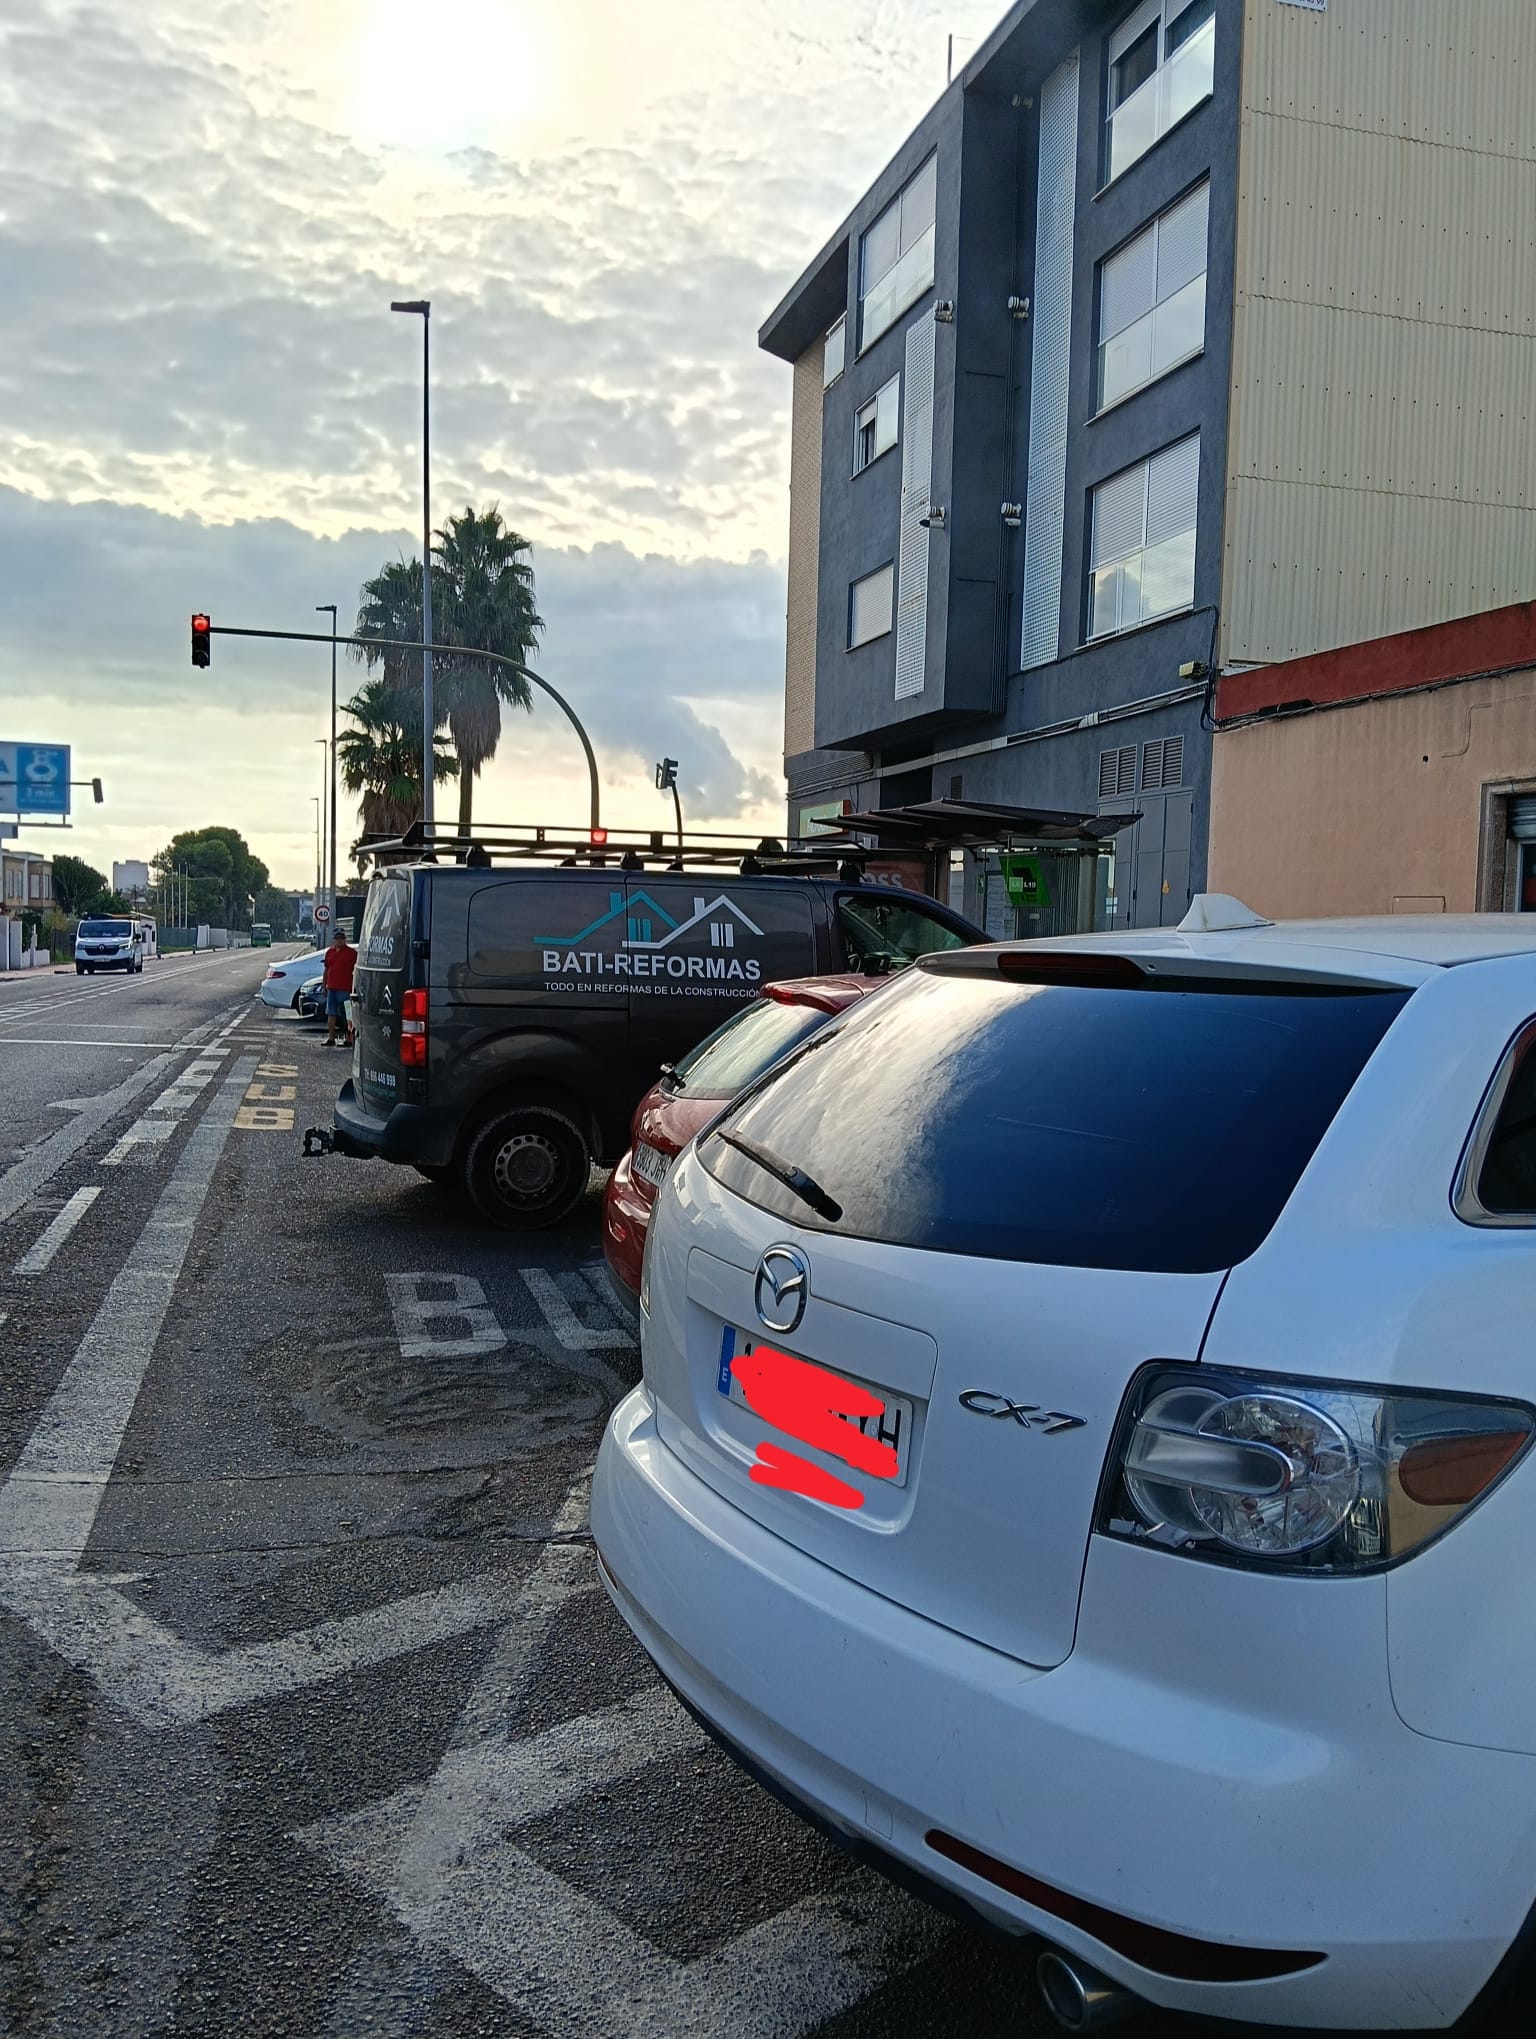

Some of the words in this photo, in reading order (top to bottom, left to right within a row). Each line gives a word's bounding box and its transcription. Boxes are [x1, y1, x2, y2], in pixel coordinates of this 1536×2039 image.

[543, 950, 761, 980] BATI-REFORMAS
[544, 982, 575, 992] TODO
[577, 982, 592, 992] EN
[594, 983, 652, 994] REFORMAS
[654, 985, 669, 995] DE
[670, 986, 683, 996] LA
[721, 1367, 729, 1383] E
[958, 1387, 1088, 1435] CX-7
